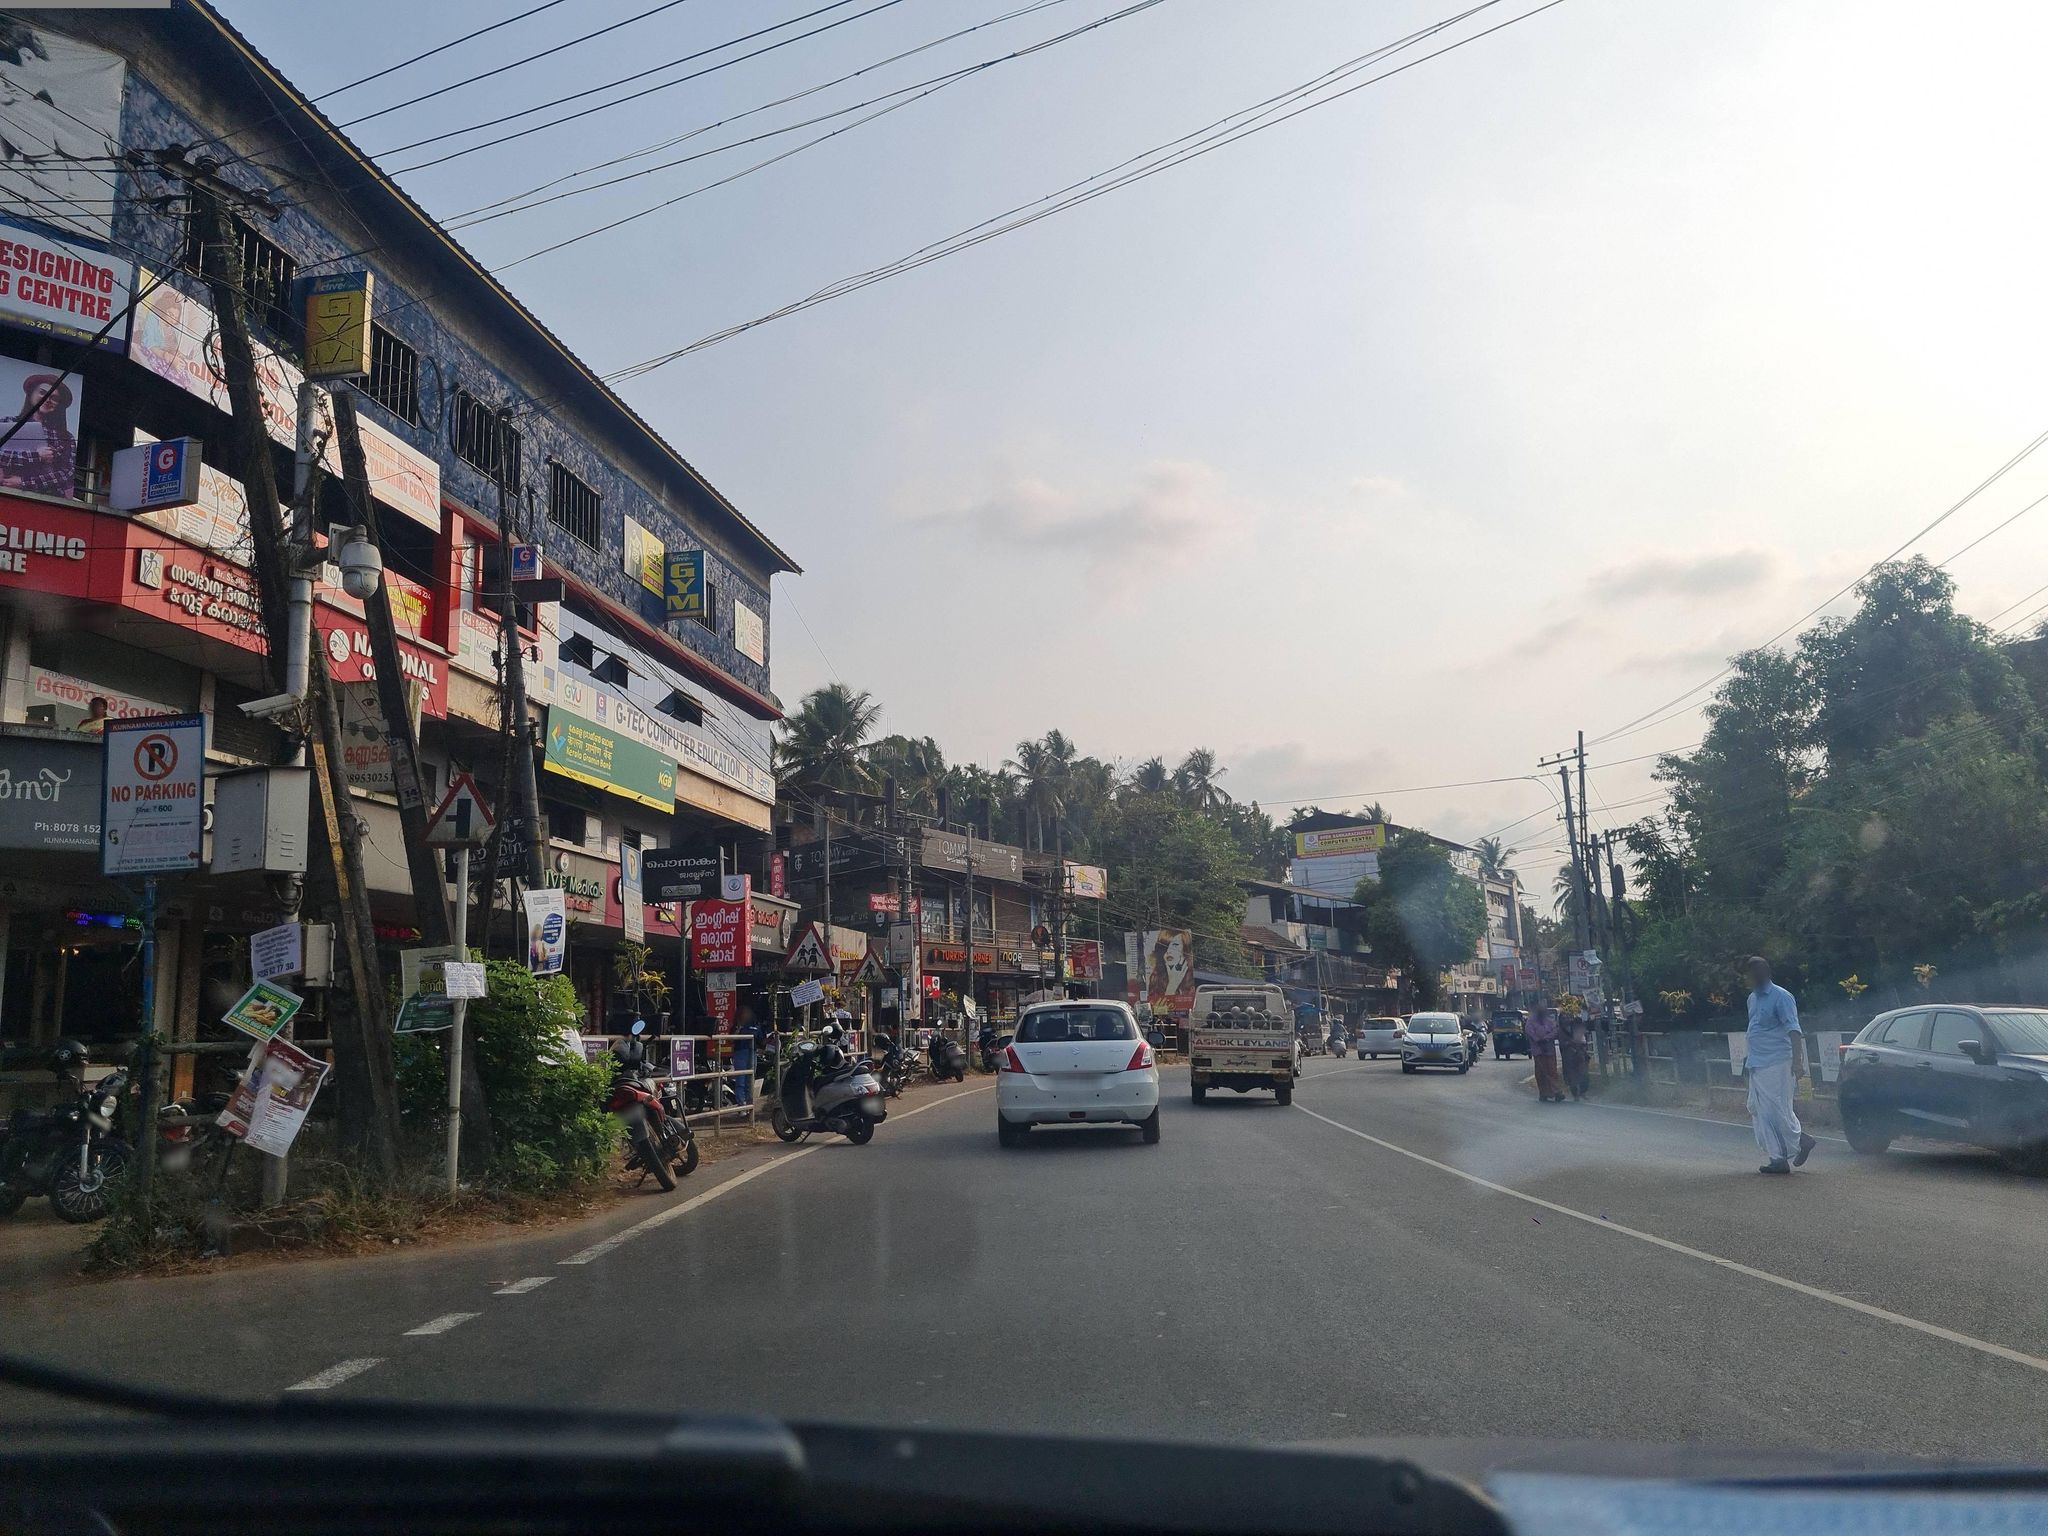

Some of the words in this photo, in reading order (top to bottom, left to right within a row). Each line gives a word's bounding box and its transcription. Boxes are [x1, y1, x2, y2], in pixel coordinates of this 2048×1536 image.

[17, 275, 112, 321] CENTRE
[151, 481, 178, 490] COMPUTER
[157, 473, 172, 482] TEC
[667, 563, 699, 610] GYM
[170, 587, 180, 604] &
[176, 719, 200, 727] POLICE
[615, 702, 645, 736] G-TEC
[646, 718, 696, 759] COMPUTER
[698, 739, 741, 779] EDUCATION
[566, 746, 583, 760] Kerala
[600, 759, 612, 770] Bank
[658, 771, 673, 787] KGB
[111, 785, 131, 803] NO
[135, 782, 197, 801] PARKING
[158, 804, 173, 813] 600
[34, 822, 80, 833] Ph:8078
[82, 824, 101, 834] 152
[810, 846, 842, 863] TOMY
[569, 876, 604, 898] Medicas
[700, 927, 736, 948] മരുന്ന്
[969, 952, 993, 964] ORNER
[1002, 951, 1023, 966] nope
[1195, 1039, 1234, 1047] ASHOK
[1237, 1039, 1289, 1048] LEYLAND
